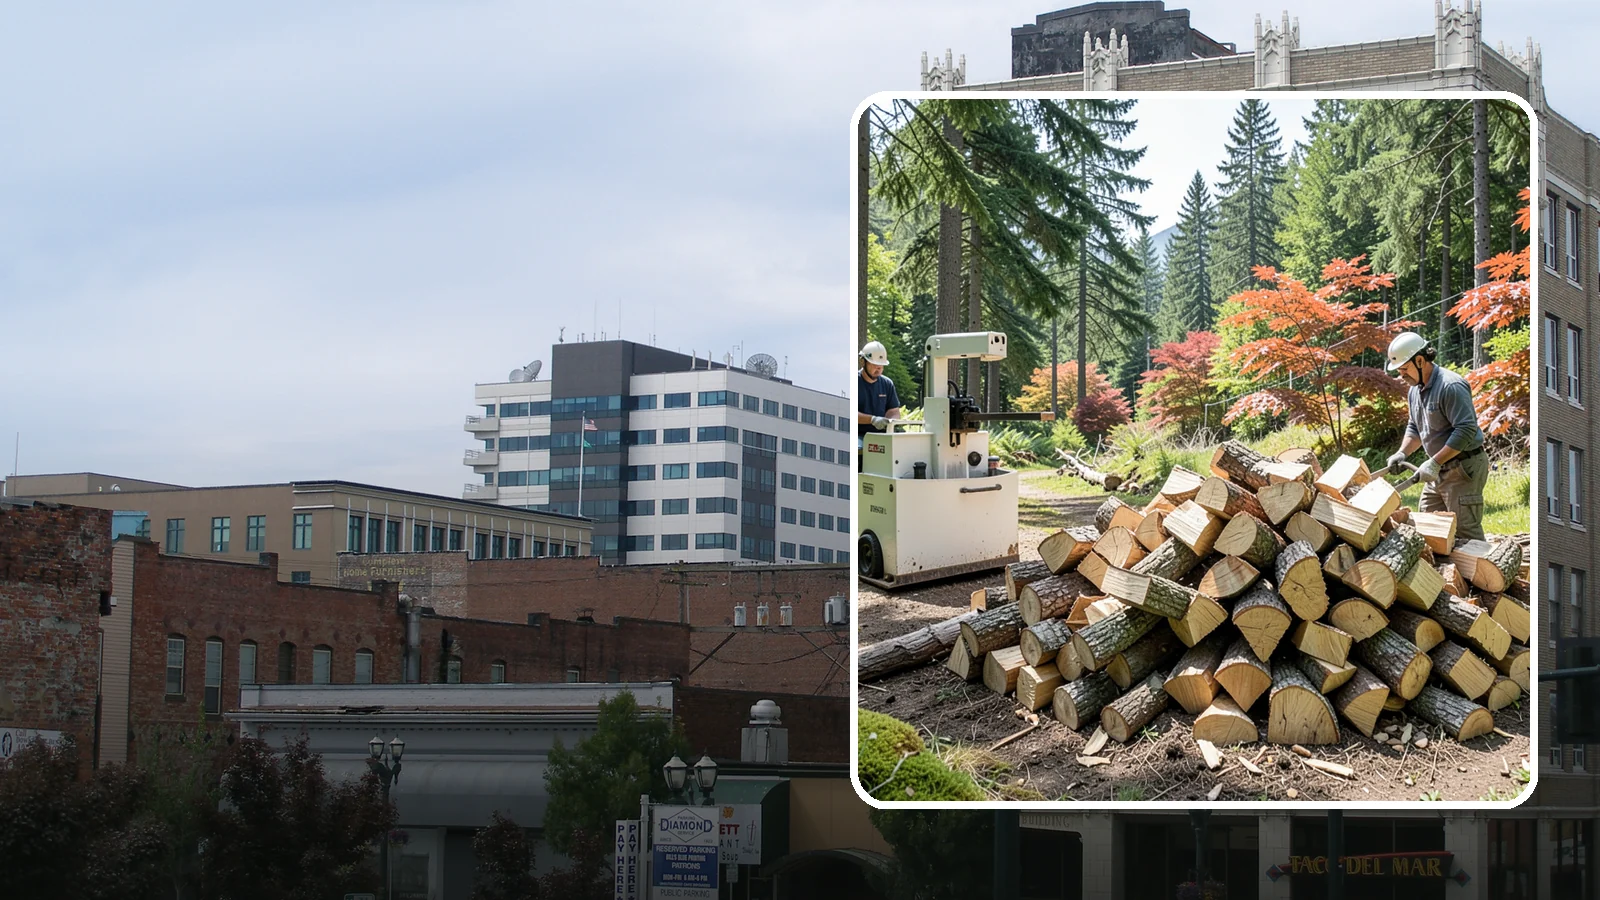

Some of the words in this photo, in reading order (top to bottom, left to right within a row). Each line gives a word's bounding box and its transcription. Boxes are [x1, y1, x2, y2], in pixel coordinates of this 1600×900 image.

[362, 557, 406, 567] Complete
[343, 568, 368, 577] Home
[370, 566, 427, 576] Furnishers
[660, 818, 713, 832] DIAMOND
[1022, 815, 1070, 827] BUILDING
[617, 824, 625, 852] PAY
[628, 824, 637, 852] PAY
[655, 845, 688, 853] RESERVED
[689, 846, 716, 854] PARKING
[721, 851, 739, 862] Soup
[671, 862, 701, 870] PATRONS
[1345, 856, 1385, 875] DEL
[1392, 857, 1442, 876] MAR
[616, 856, 625, 893] HERE
[627, 856, 636, 893] HERE
[660, 889, 682, 897] PUBLIC
[683, 889, 710, 898] PARKING
